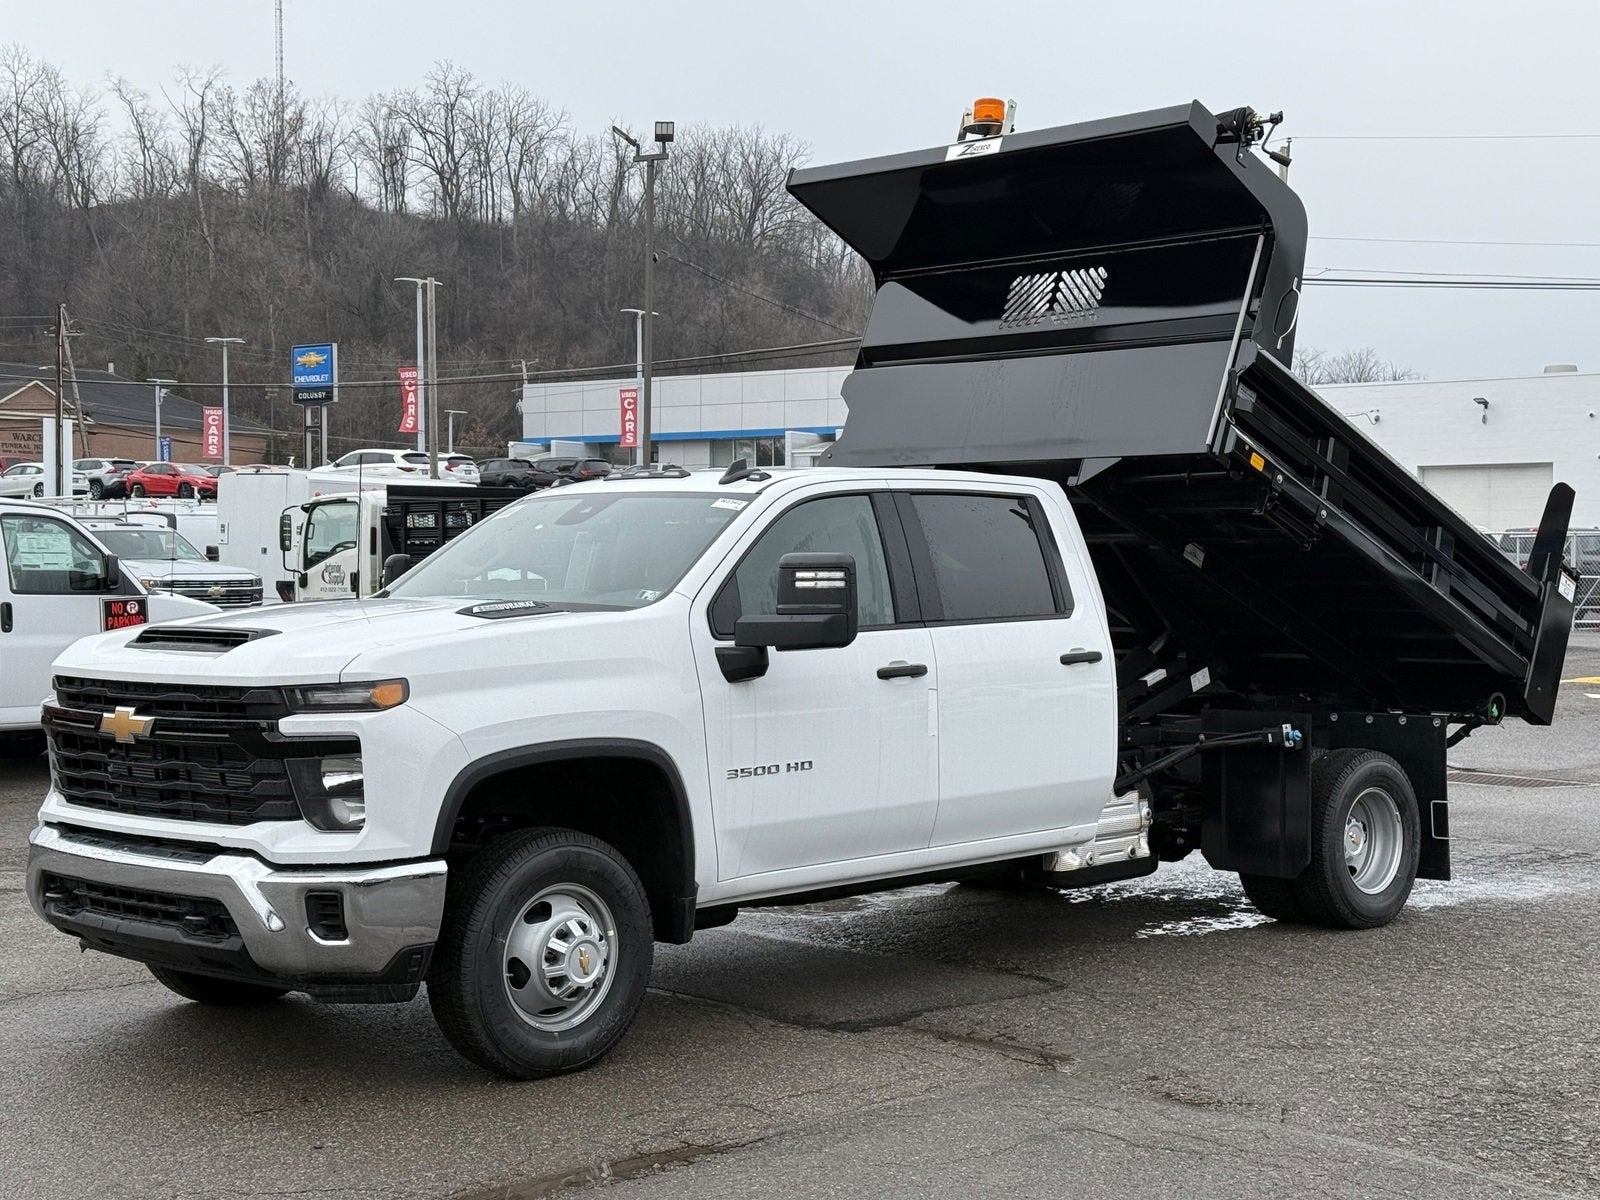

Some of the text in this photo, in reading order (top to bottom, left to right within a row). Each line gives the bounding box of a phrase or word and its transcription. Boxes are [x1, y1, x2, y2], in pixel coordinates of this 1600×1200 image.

[294, 374, 329, 383] CHEVROLET
[400, 371, 418, 379] USED
[298, 391, 326, 400] COLUSSY
[404, 379, 416, 429] CARS
[623, 398, 635, 443] CARS
[207, 415, 219, 455] CARS
[111, 602, 124, 615] NO
[107, 615, 146, 629] PARKING
[726, 760, 813, 780] 3500 HD
